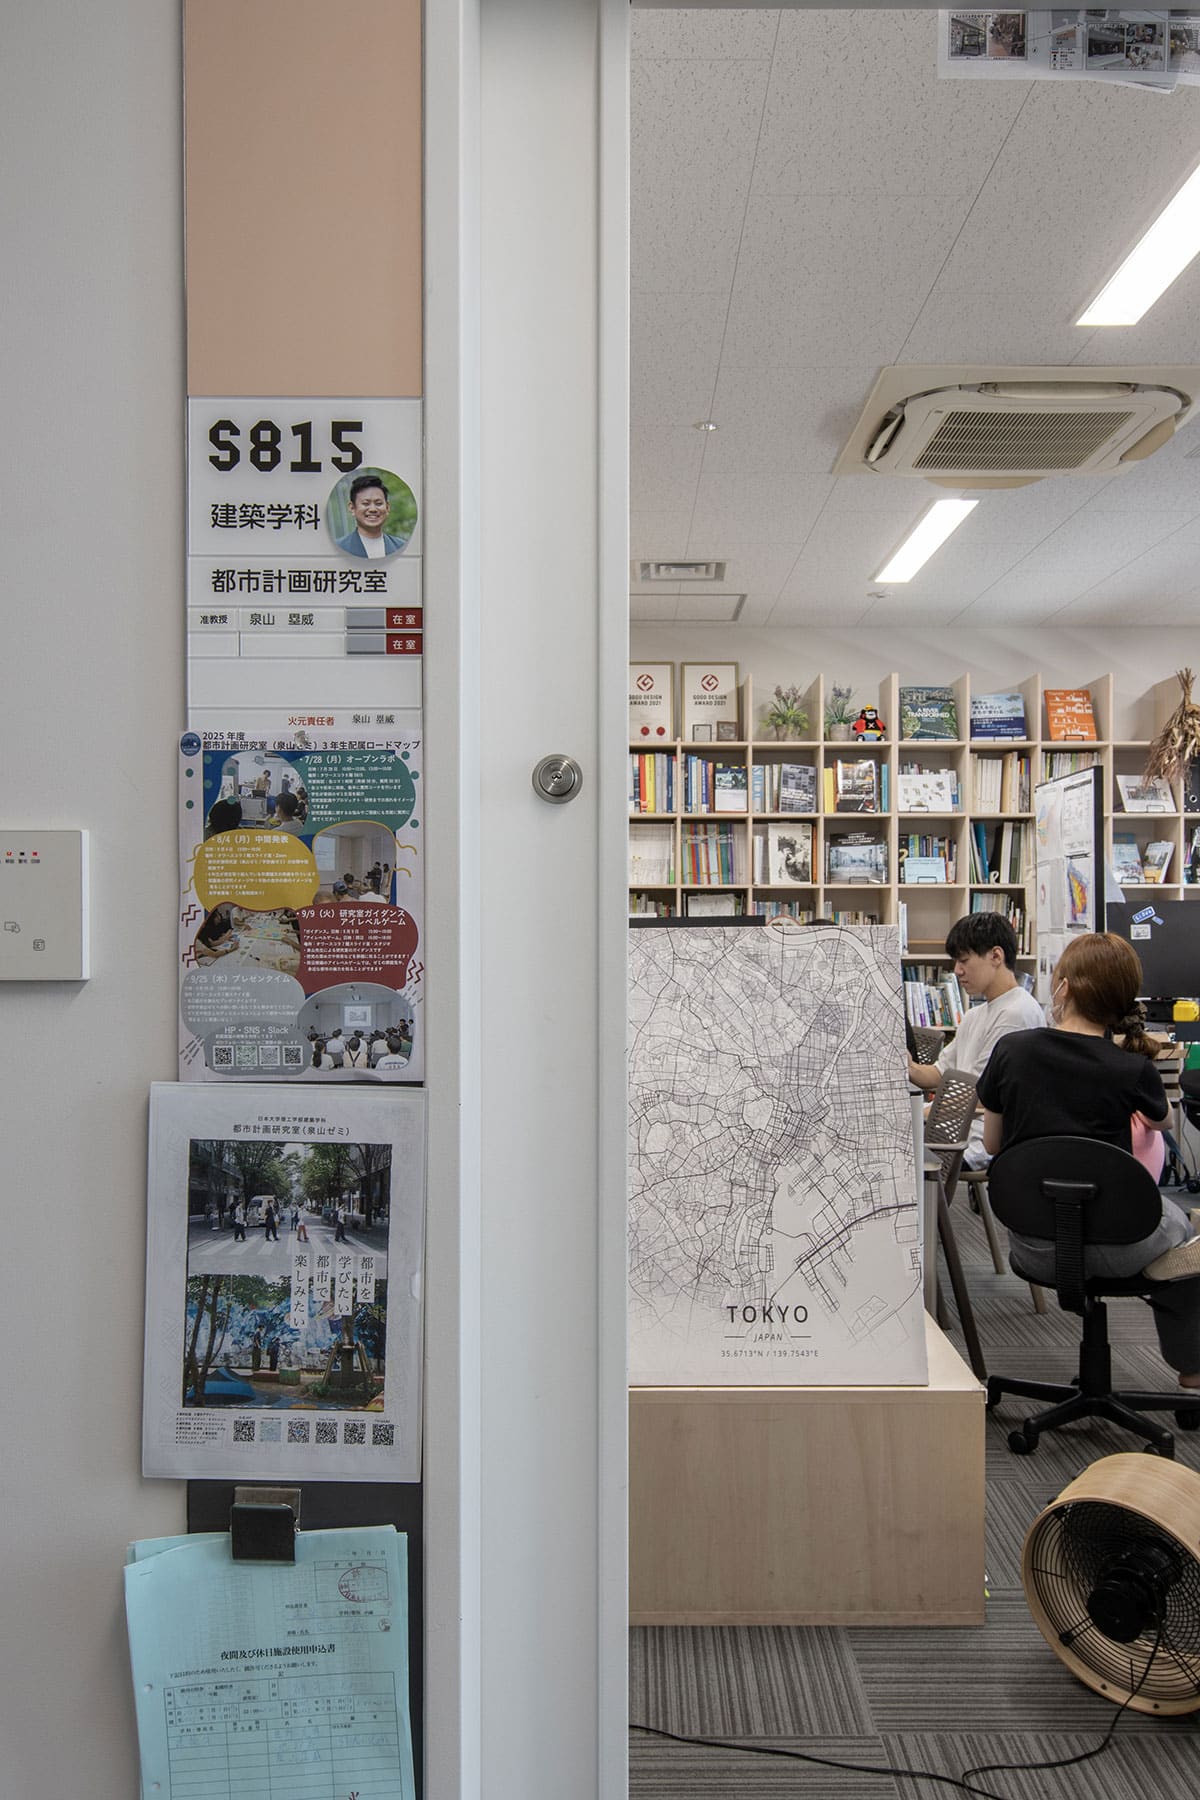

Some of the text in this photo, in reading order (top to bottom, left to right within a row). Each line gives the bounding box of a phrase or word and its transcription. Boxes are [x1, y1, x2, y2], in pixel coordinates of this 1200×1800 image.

[209, 419, 363, 472] S815
[210, 503, 320, 530] 建築学科
[211, 569, 387, 593] 都市計画研究室
[200, 614, 228, 625] 准教授
[250, 613, 275, 625] 泉山
[392, 614, 416, 625] 在室
[392, 640, 416, 650] 在室
[288, 716, 334, 726] 火元責任者
[352, 714, 370, 724] 泉山
[340, 918, 406, 926] アイレベルゲーム
[316, 1255, 330, 1298] 都市で
[338, 1255, 352, 1313] 学びたい
[360, 1256, 374, 1300] 都市を
[294, 1254, 307, 1327] 楽しみたい
[726, 1305, 808, 1323] TOKYO
[753, 1333, 783, 1342] JAPAN
